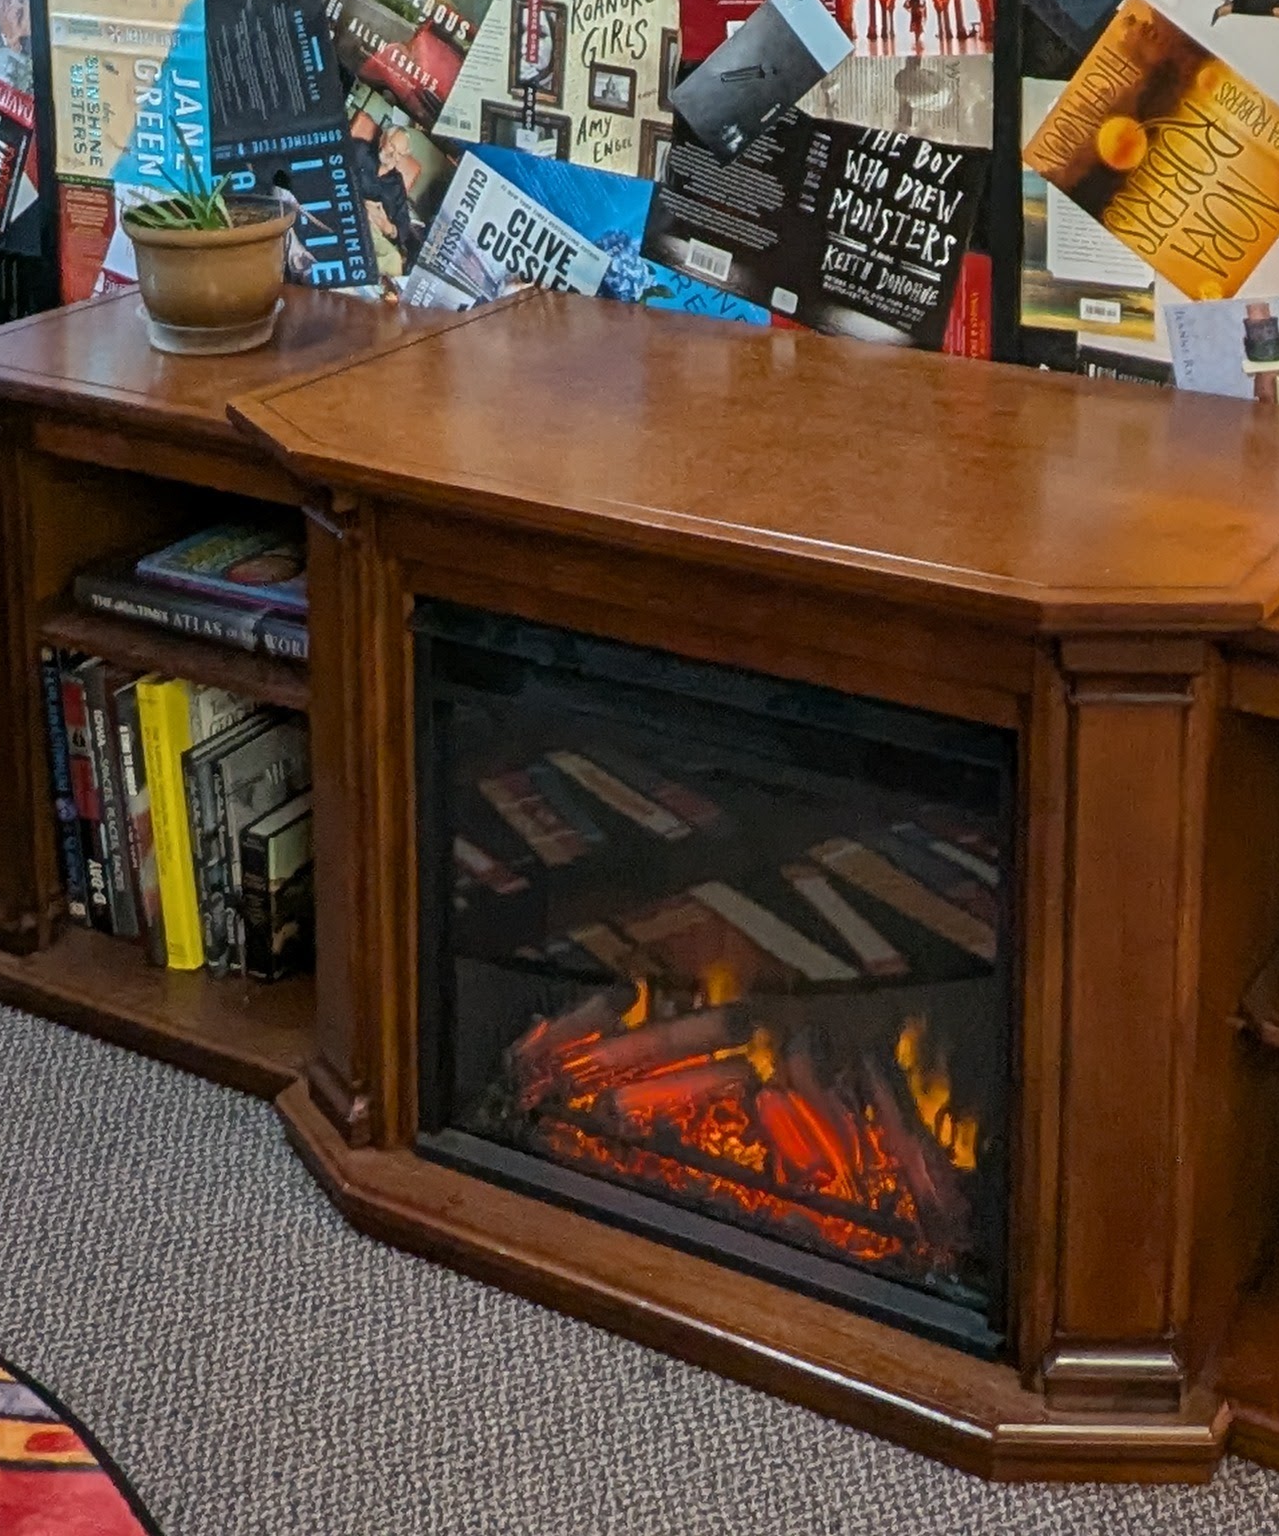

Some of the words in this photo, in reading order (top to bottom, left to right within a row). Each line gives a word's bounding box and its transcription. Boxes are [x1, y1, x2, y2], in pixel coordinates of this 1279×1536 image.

[581, 21, 648, 64] GIRLS
[133, 60, 164, 179] GREEN
[171, 73, 203, 169] JANE
[860, 129, 908, 158] THE
[913, 146, 962, 183] BOY
[845, 151, 888, 189] WHO
[896, 179, 964, 223] DREW
[828, 189, 957, 266] MONSTERS
